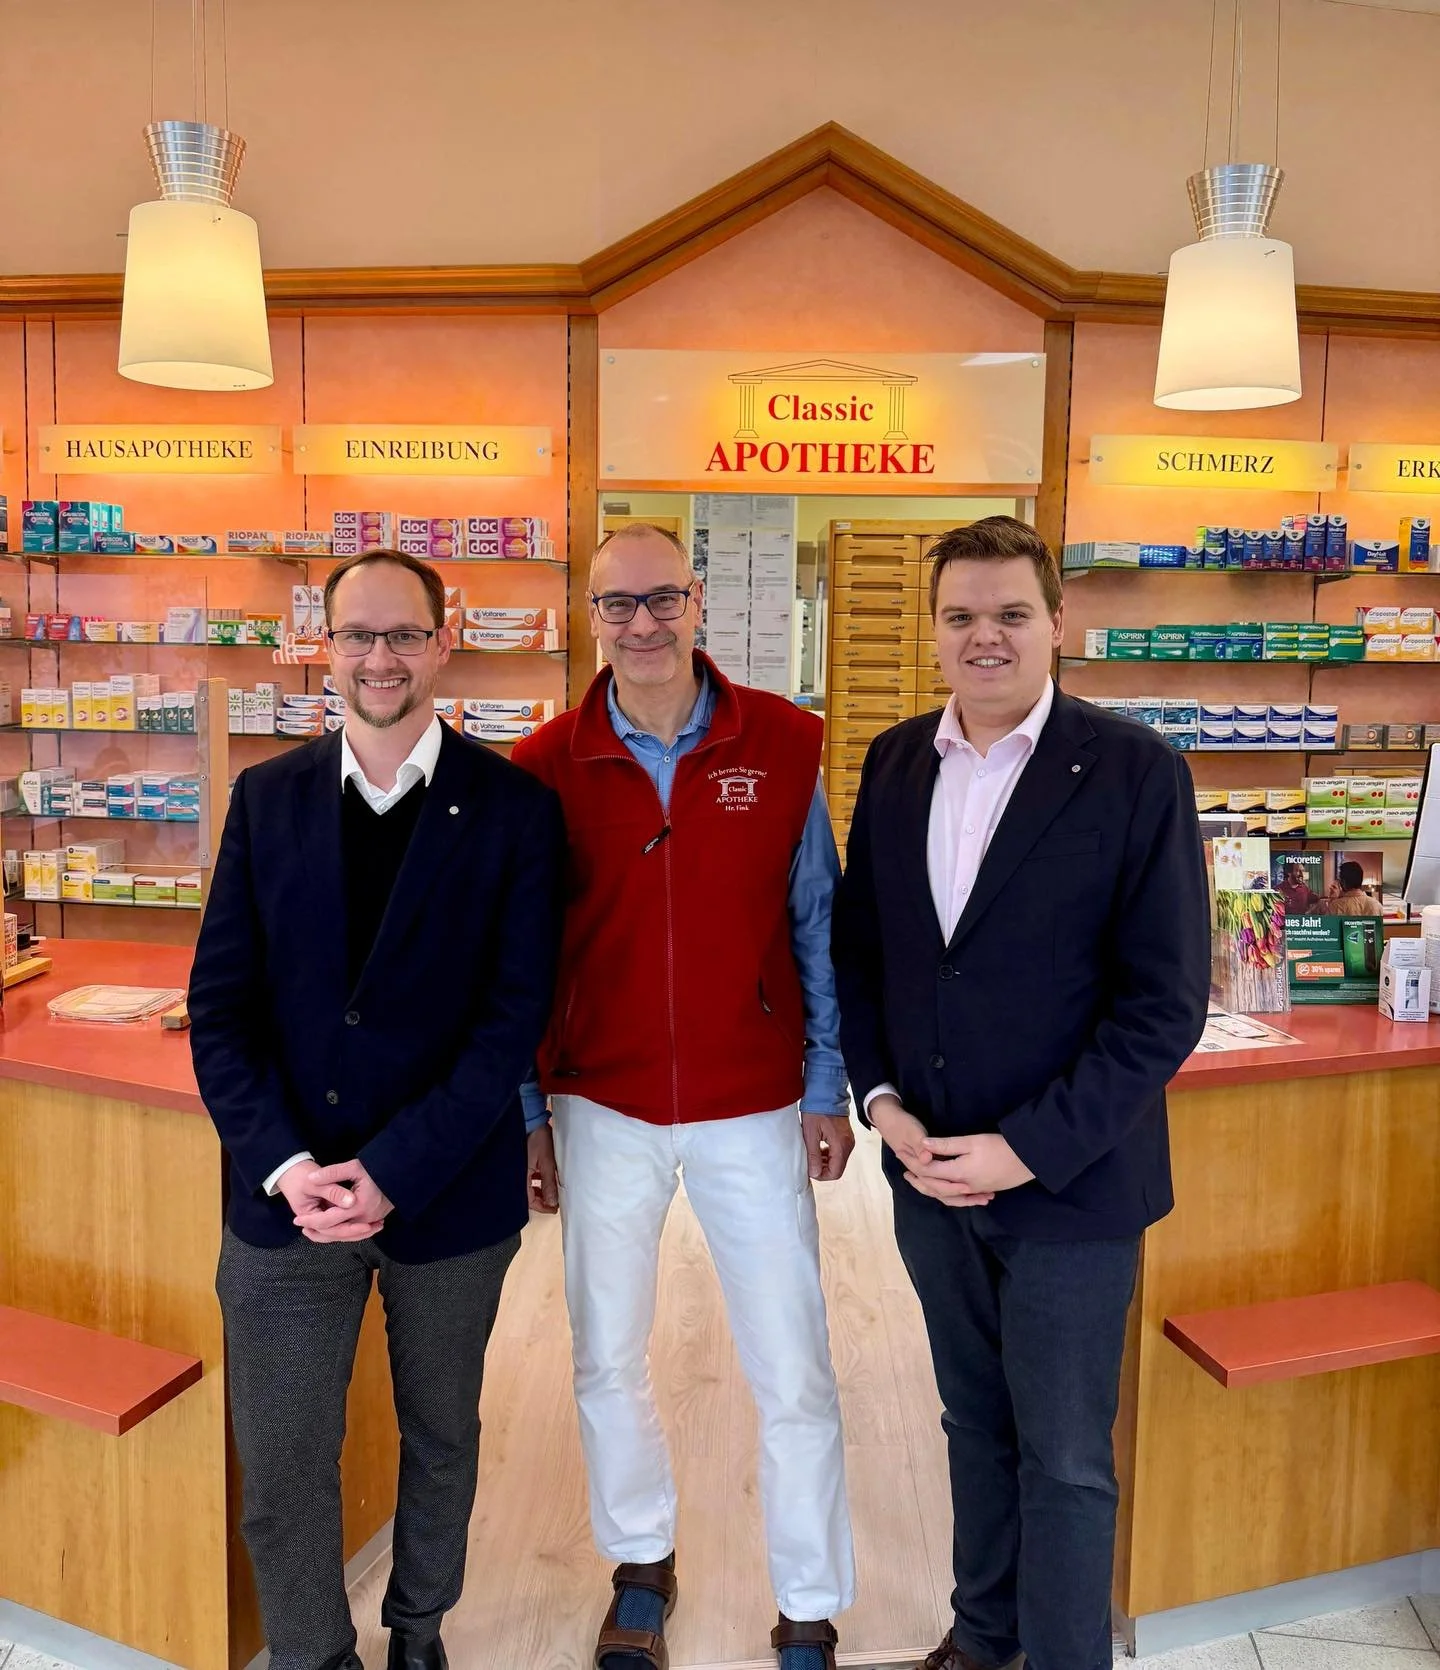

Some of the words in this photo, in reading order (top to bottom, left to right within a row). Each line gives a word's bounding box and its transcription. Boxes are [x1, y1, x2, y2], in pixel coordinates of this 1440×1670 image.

[768, 395, 874, 422] Classic
[66, 439, 253, 459] HAUSAPOTHEKE
[345, 440, 499, 460] EINREIBUNG
[705, 442, 936, 475] APOTHEKE
[1157, 451, 1275, 475] SCHMERZ
[1397, 459, 1440, 478] ERK
[335, 513, 356, 523] doc
[401, 520, 428, 533] doc
[469, 519, 498, 533] doc
[228, 531, 267, 540] RIOPAN
[285, 532, 324, 540] RIOPAN
[335, 528, 356, 538] doc
[335, 543, 356, 553] doc
[401, 540, 428, 552] doc
[469, 540, 498, 553] doc
[481, 610, 507, 618] Voltaren
[479, 631, 505, 639] Voltaren
[1117, 632, 1146, 640] ASPIRIN
[1157, 632, 1186, 640] ASPIRIN
[479, 702, 505, 710] Voltaren
[480, 722, 505, 730] Voltaren
[708, 771, 718, 780] Ich
[718, 767, 738, 776] berate
[739, 766, 747, 774] Sie
[1286, 854, 1320, 865] nicorette
[1285, 919, 1299, 927] ues
[1301, 917, 1321, 928] Jahr!
